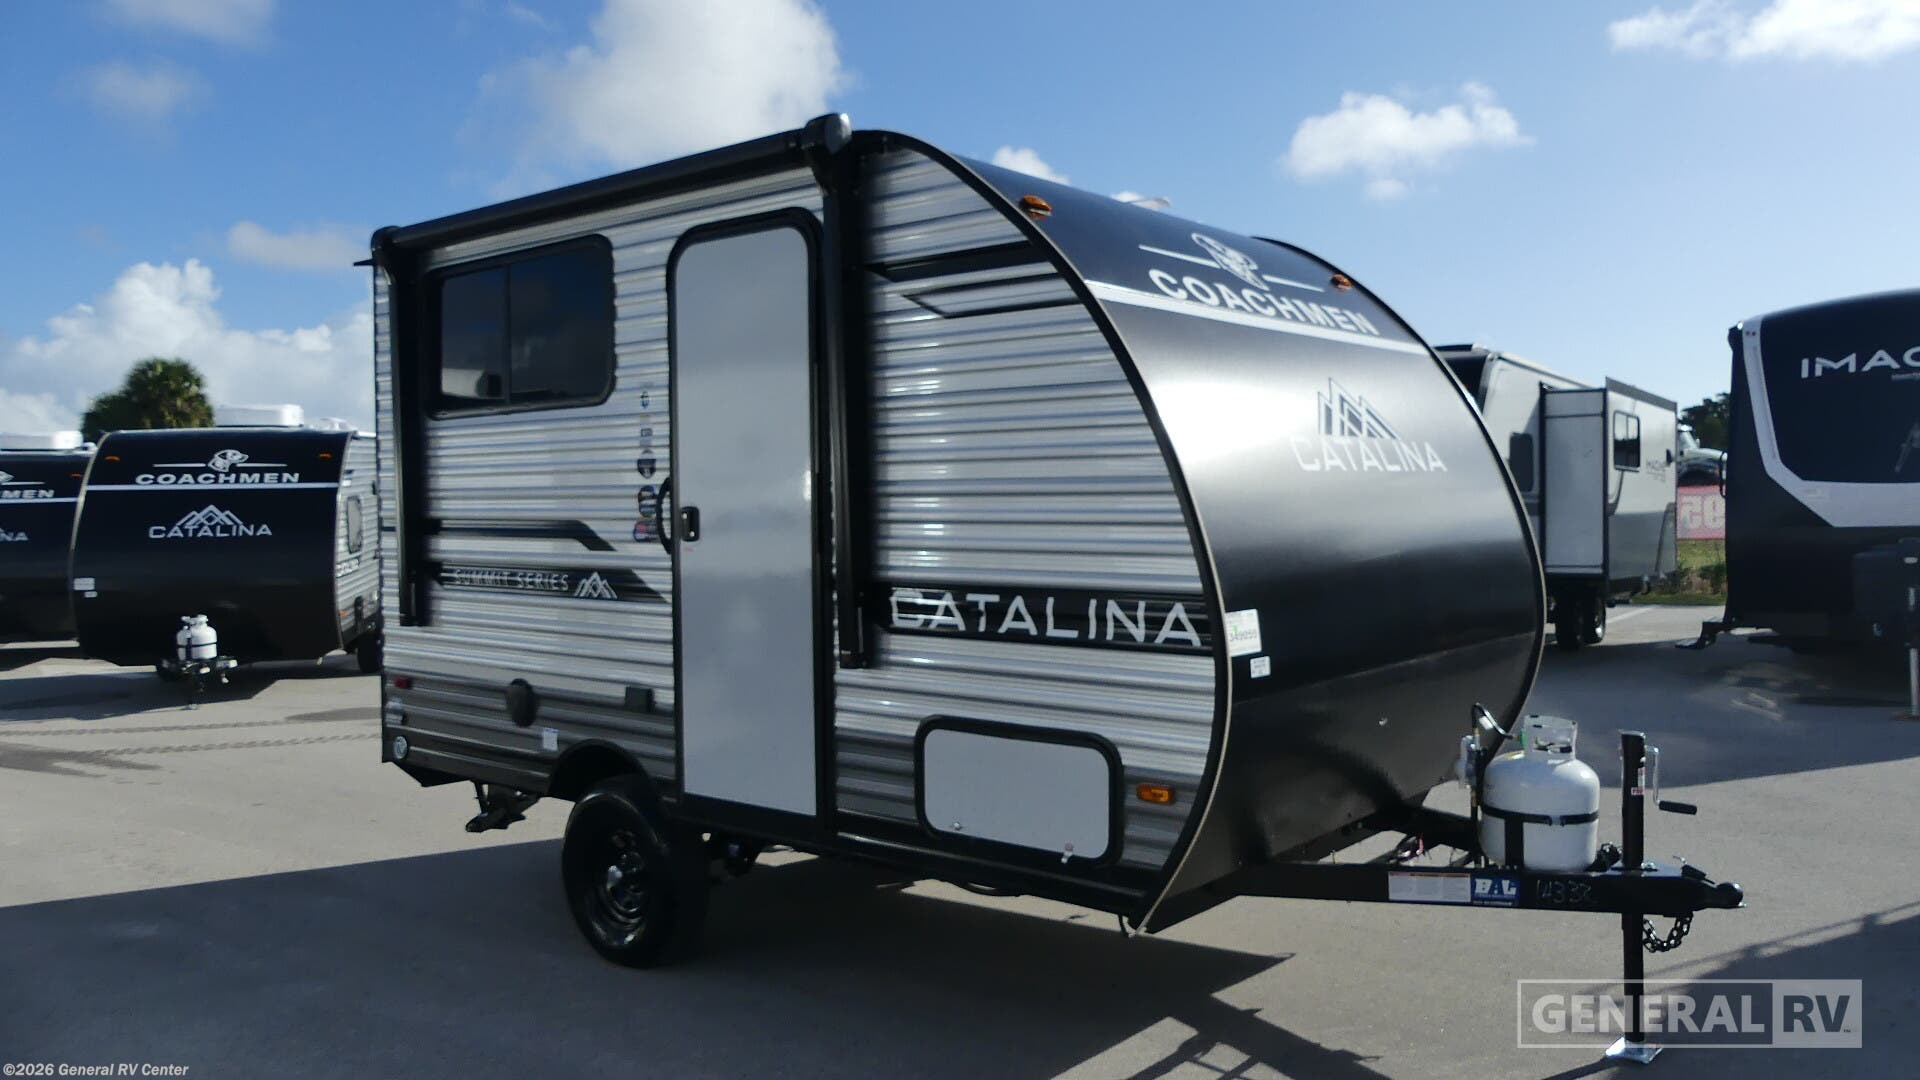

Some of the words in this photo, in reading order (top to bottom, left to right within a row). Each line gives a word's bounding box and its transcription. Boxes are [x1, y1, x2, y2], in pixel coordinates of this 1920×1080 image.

[1148, 268, 1380, 336] COACHMEN
[1290, 436, 1448, 473] CATALINA
[135, 472, 300, 485] COACHMEN
[149, 523, 273, 539] CATALINA
[455, 569, 510, 586] SUMMIT
[517, 572, 569, 591] SERIES
[890, 588, 1202, 648] CATALINA
